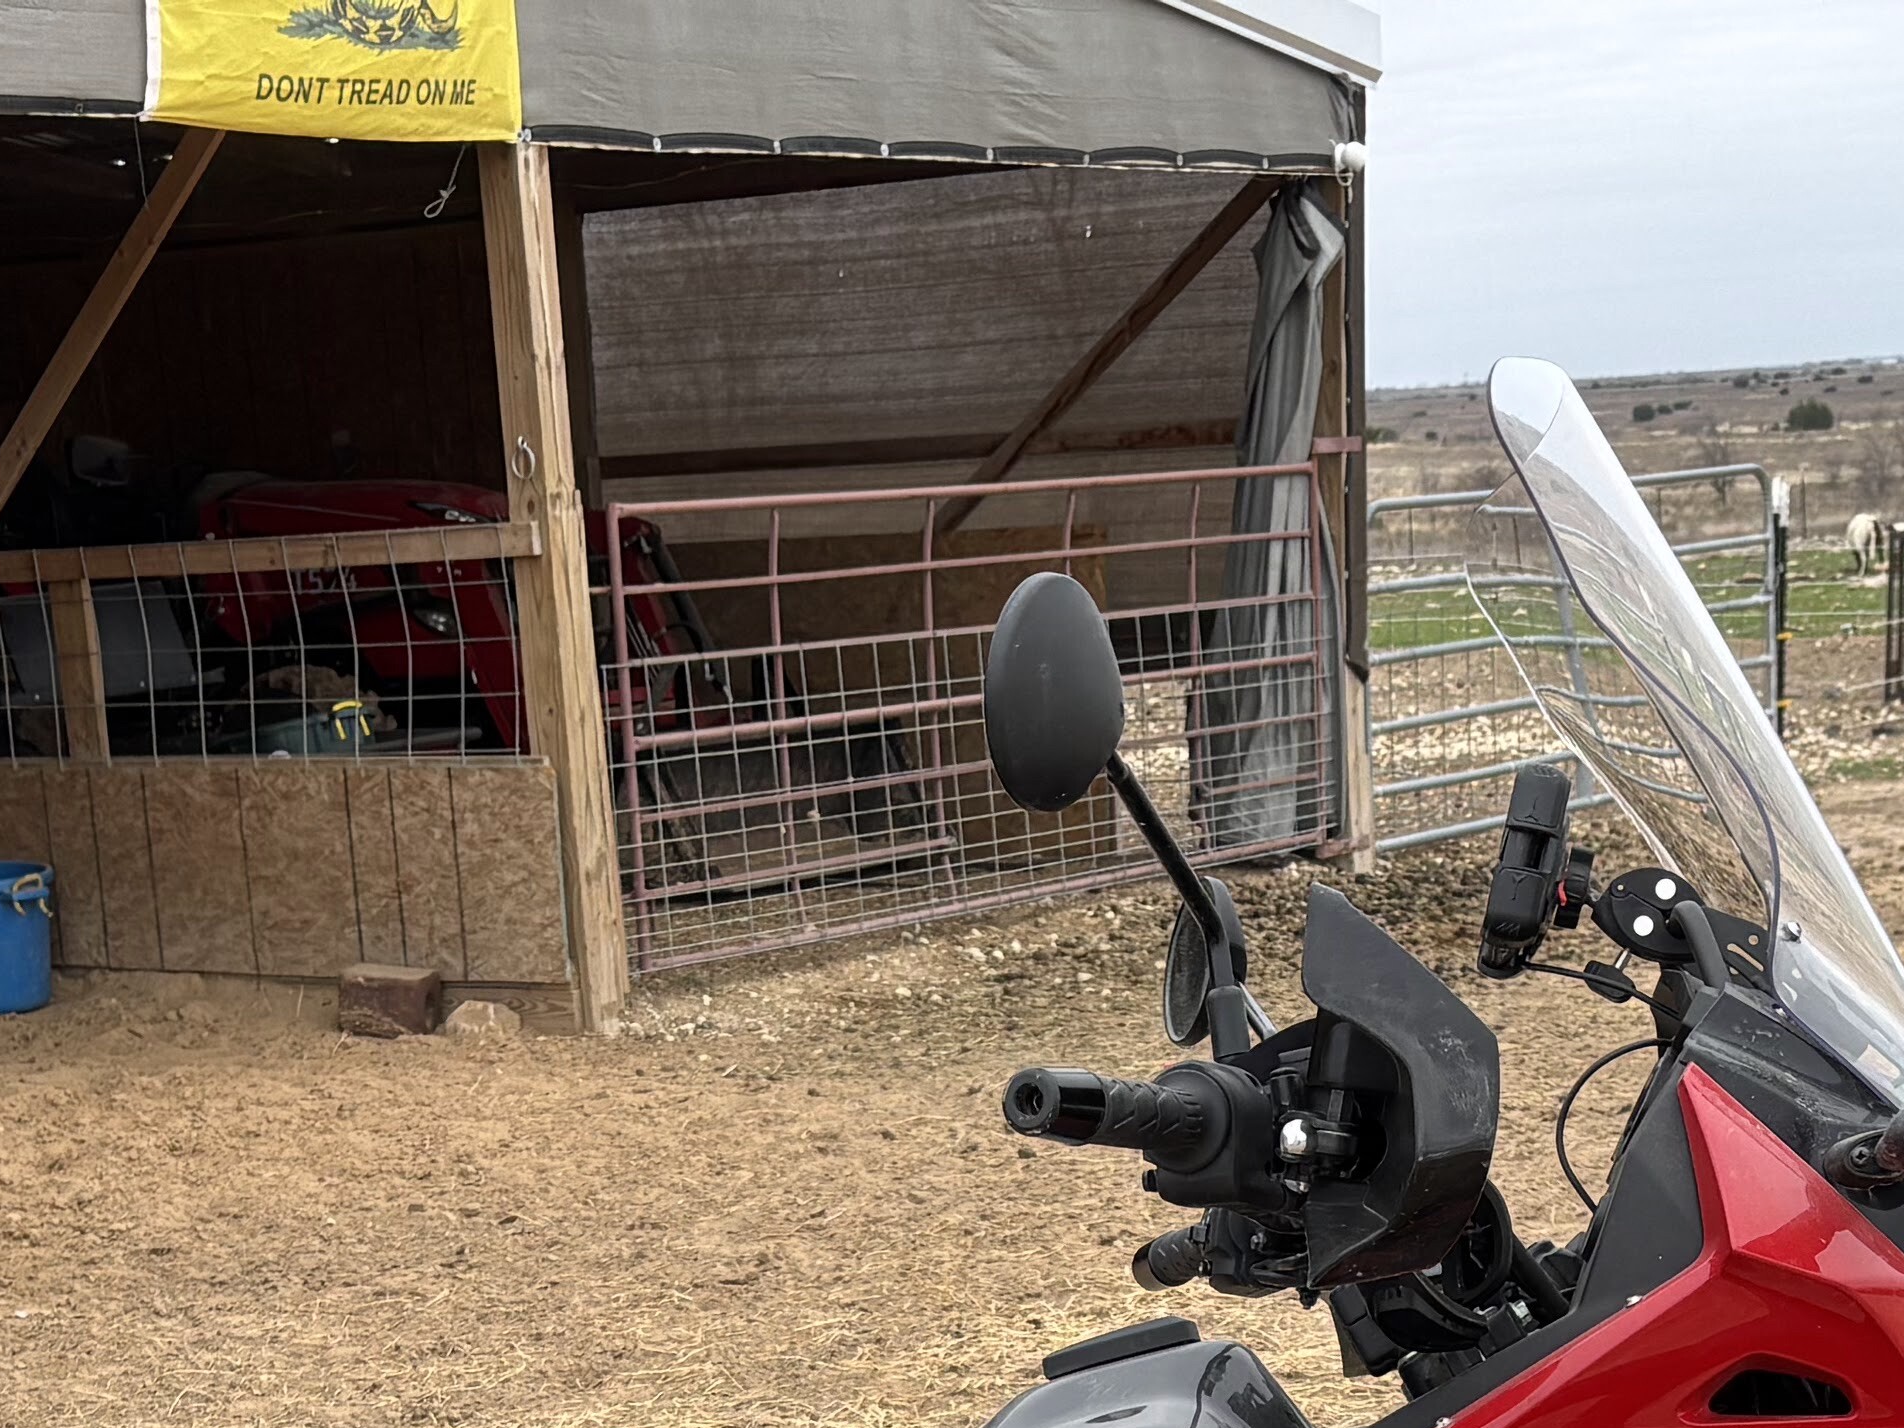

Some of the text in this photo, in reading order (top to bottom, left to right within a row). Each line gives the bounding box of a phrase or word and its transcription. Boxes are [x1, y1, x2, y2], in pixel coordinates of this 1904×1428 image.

[255, 73, 477, 106] DONT TREAD ON ME
